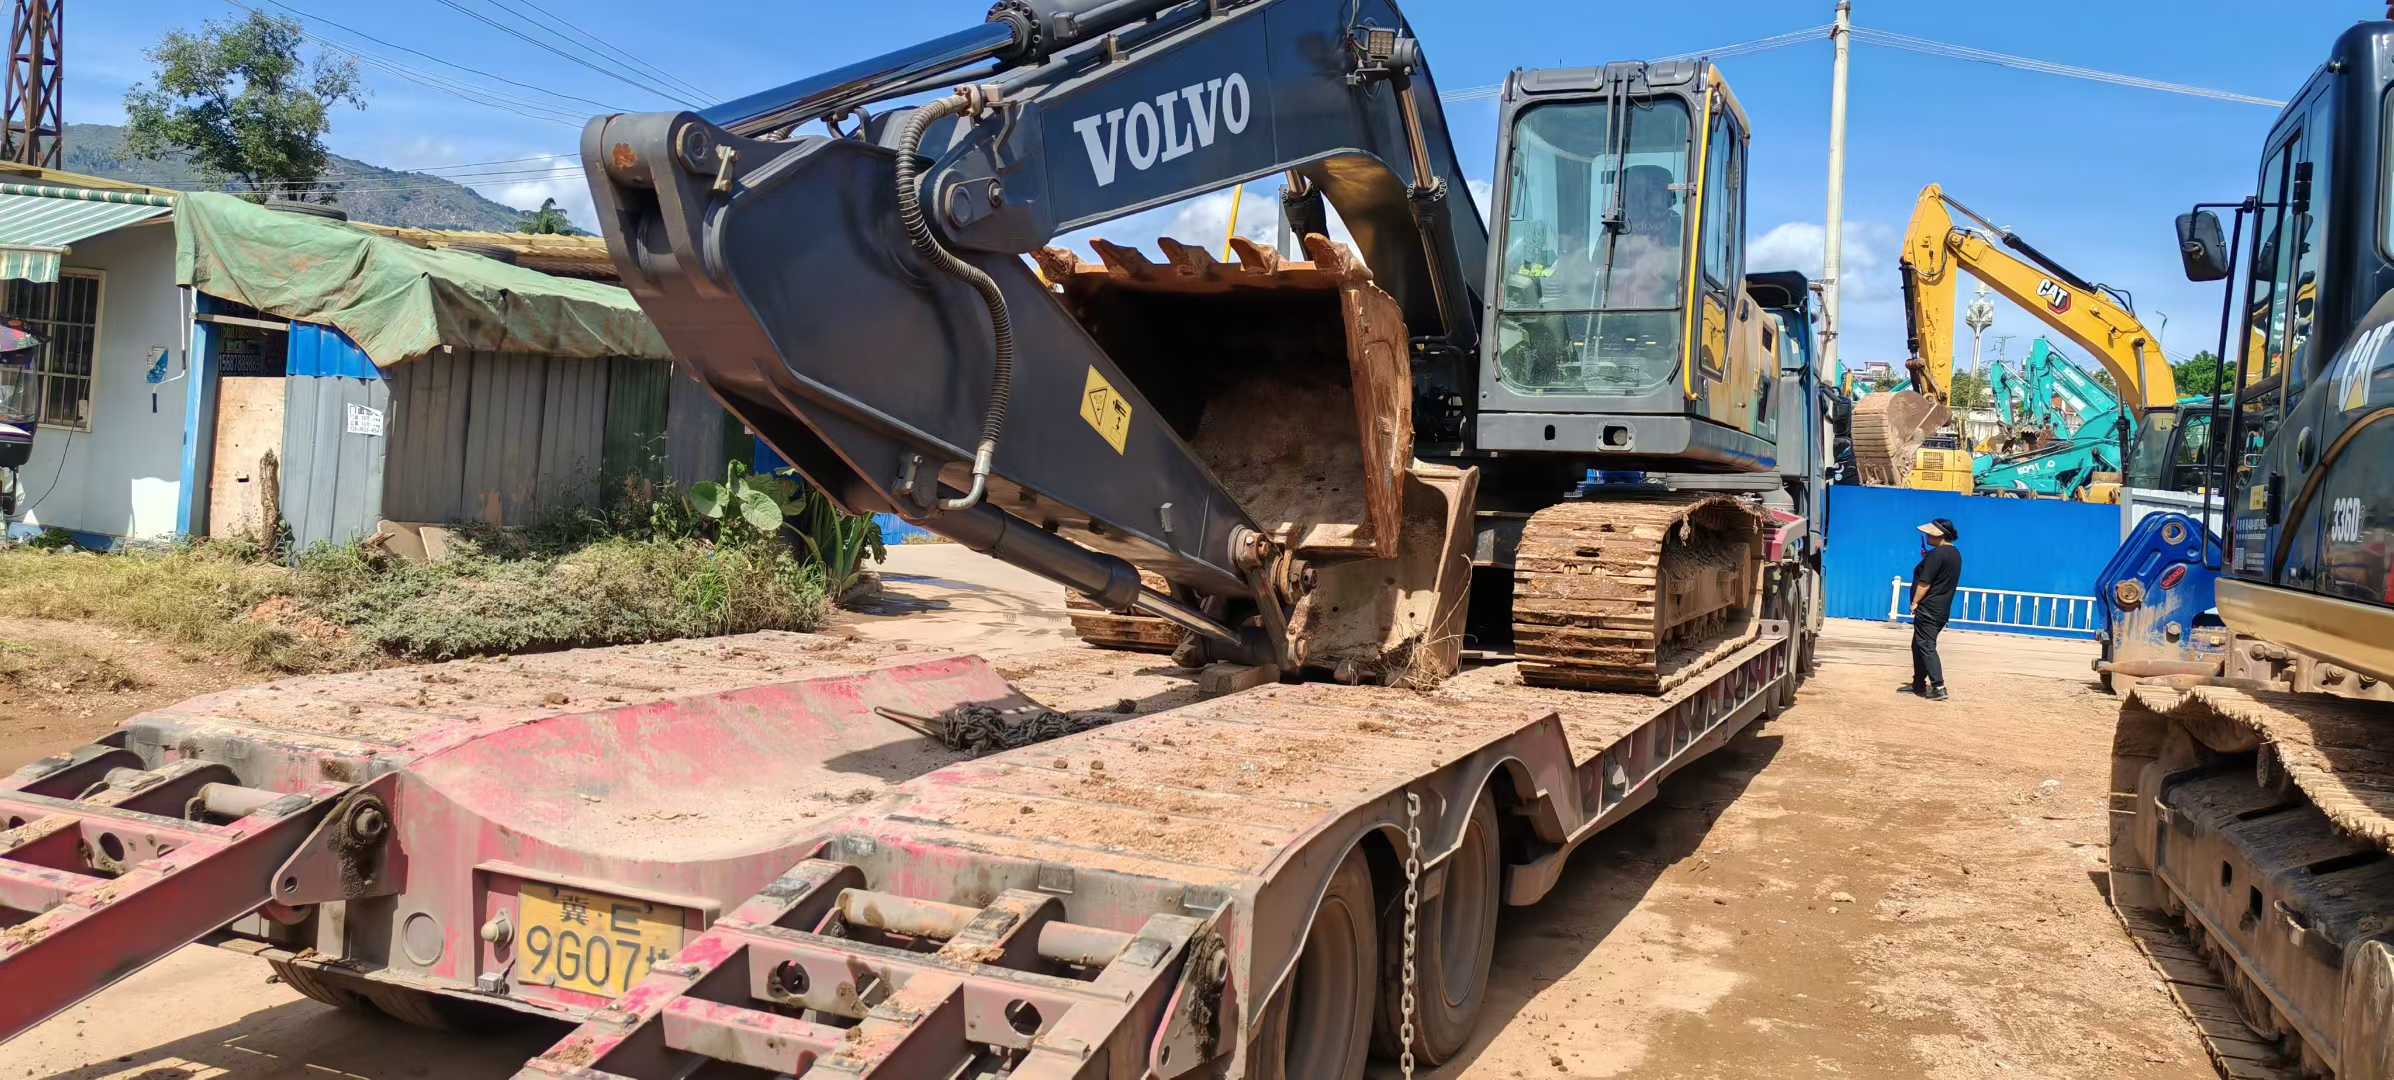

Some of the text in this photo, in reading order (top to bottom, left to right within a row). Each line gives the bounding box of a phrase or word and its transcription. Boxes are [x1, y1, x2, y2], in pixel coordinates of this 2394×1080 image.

[1073, 72, 1250, 187] VOLVO
[2036, 278, 2068, 307] CAT
[2338, 320, 2394, 413] CAT
[2331, 497, 2361, 542] 336D
